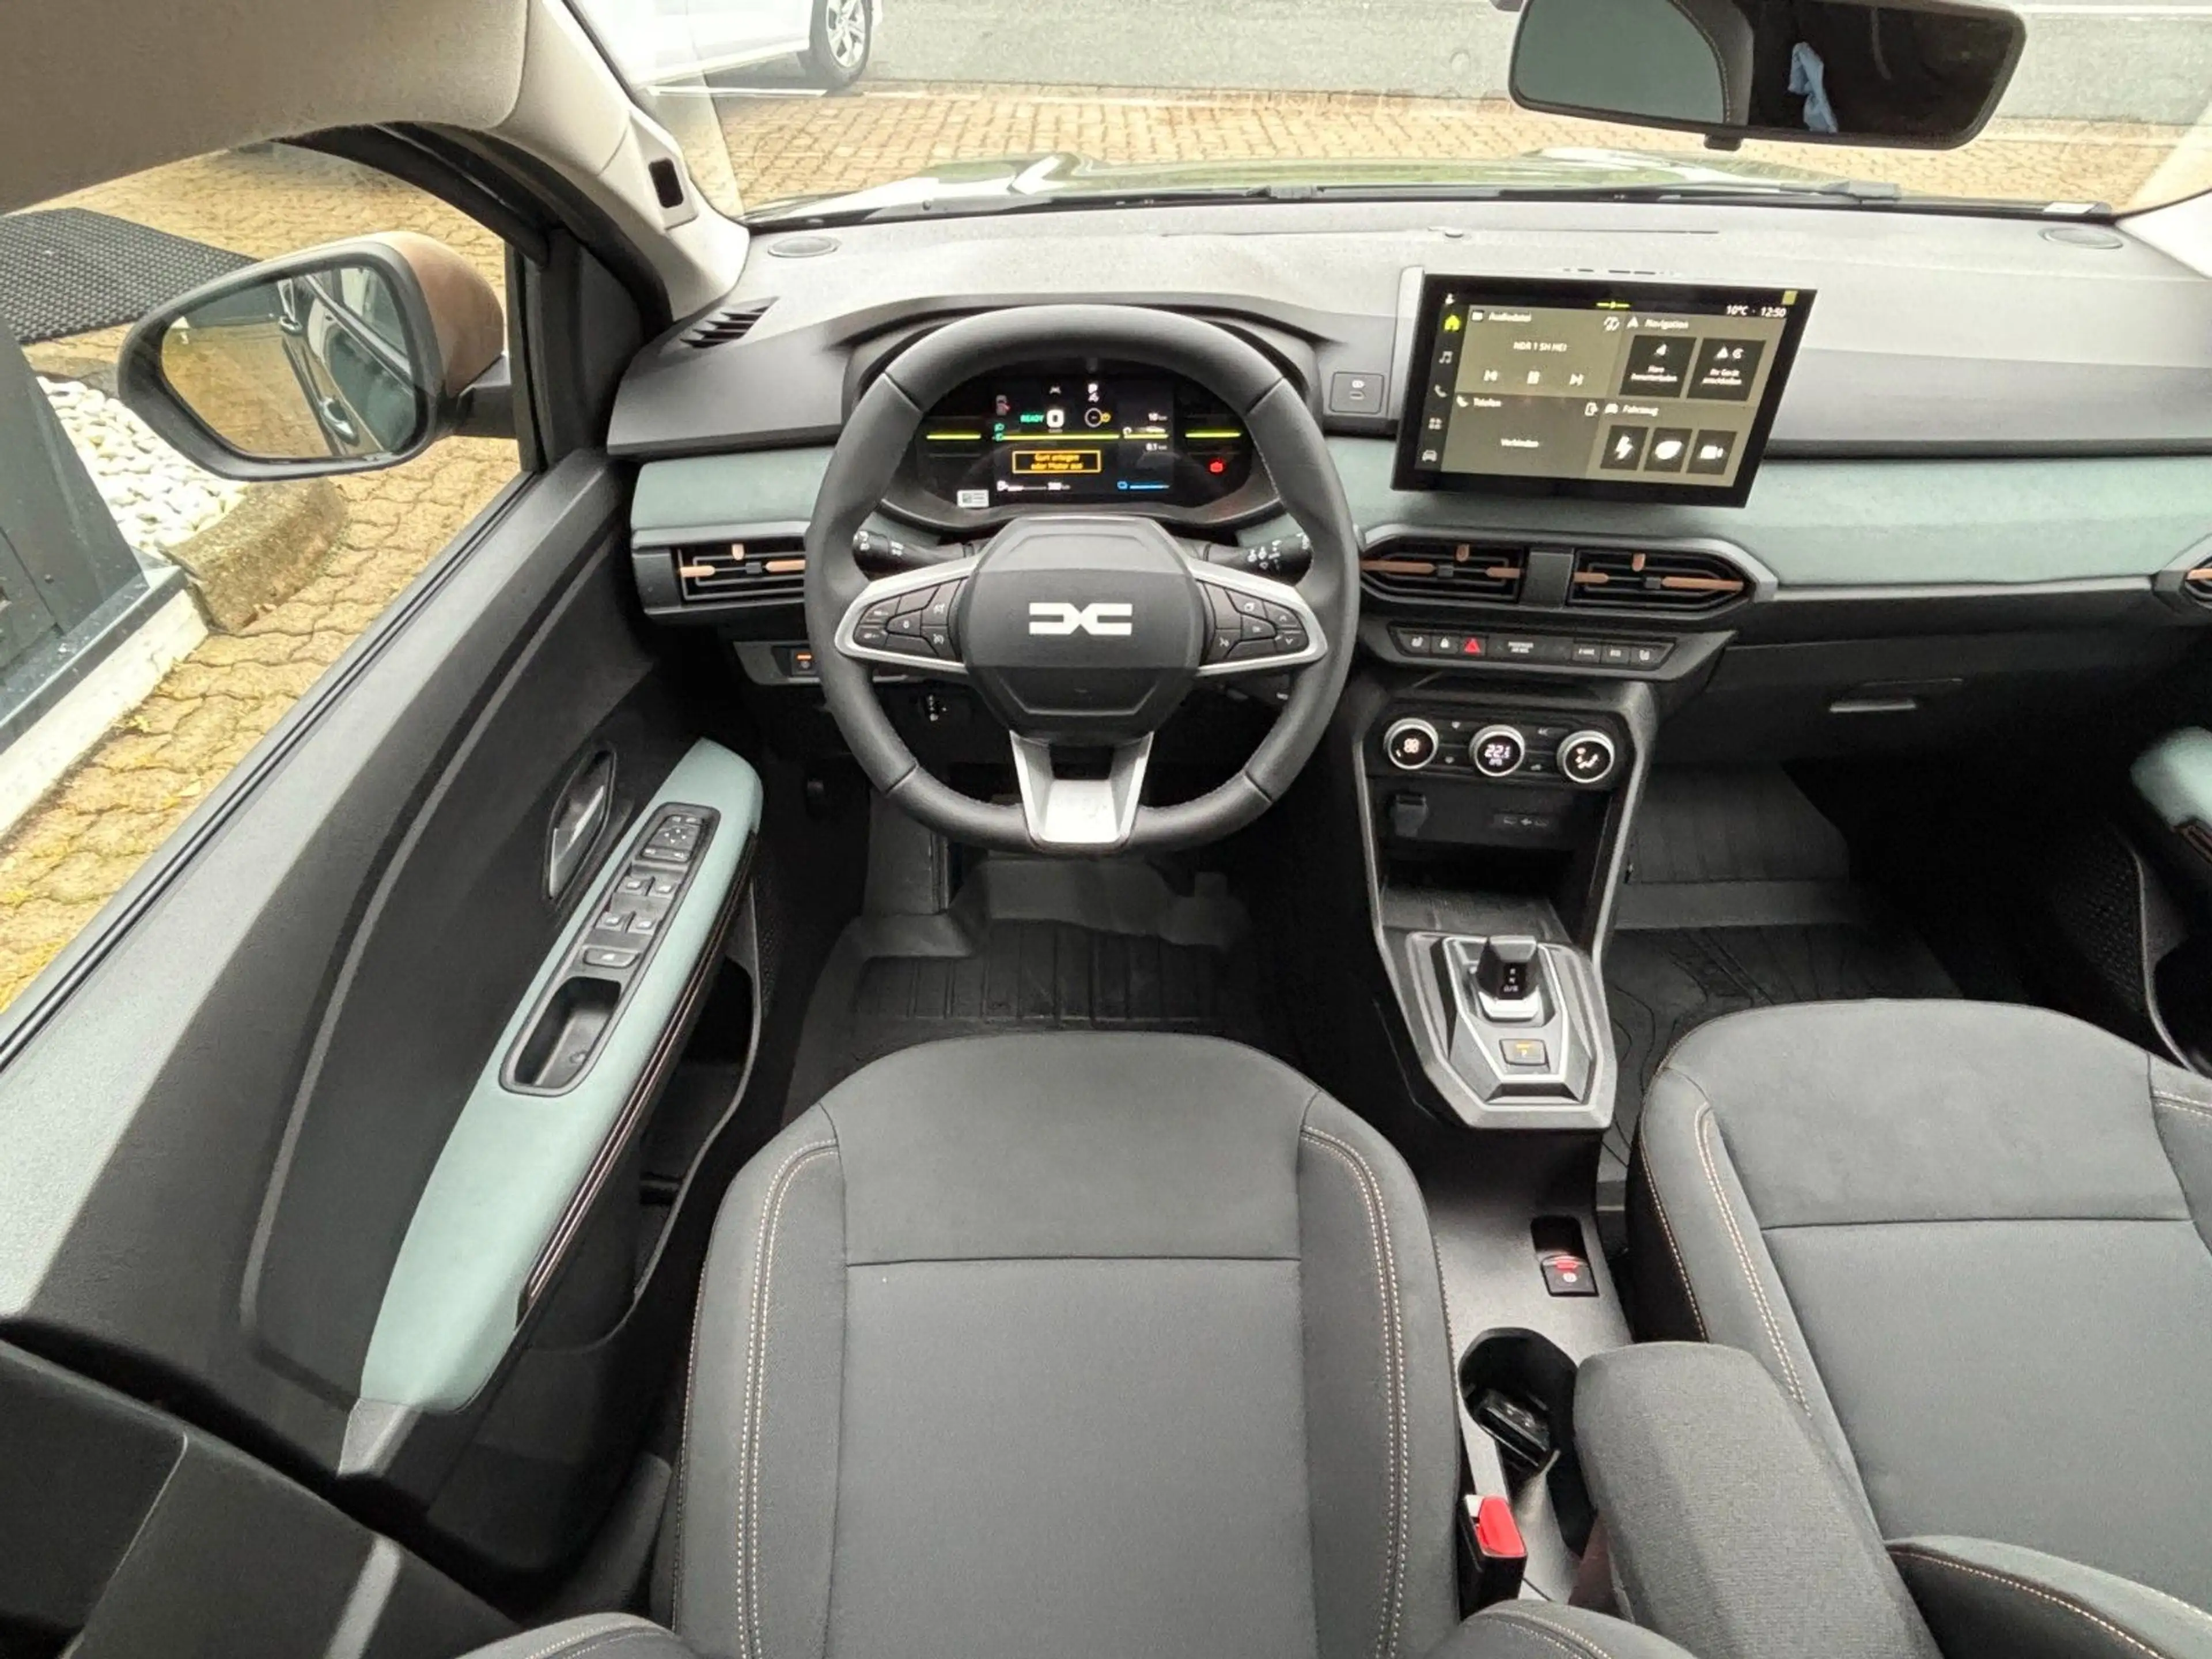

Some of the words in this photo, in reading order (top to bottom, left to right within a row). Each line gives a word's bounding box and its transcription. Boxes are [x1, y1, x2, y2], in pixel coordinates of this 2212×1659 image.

[1760, 306, 1787, 317] 12:50
[1644, 319, 1689, 329] Navigation
[1474, 397, 1502, 407] Telefon
[1622, 404, 1659, 417] Fahrzeug
